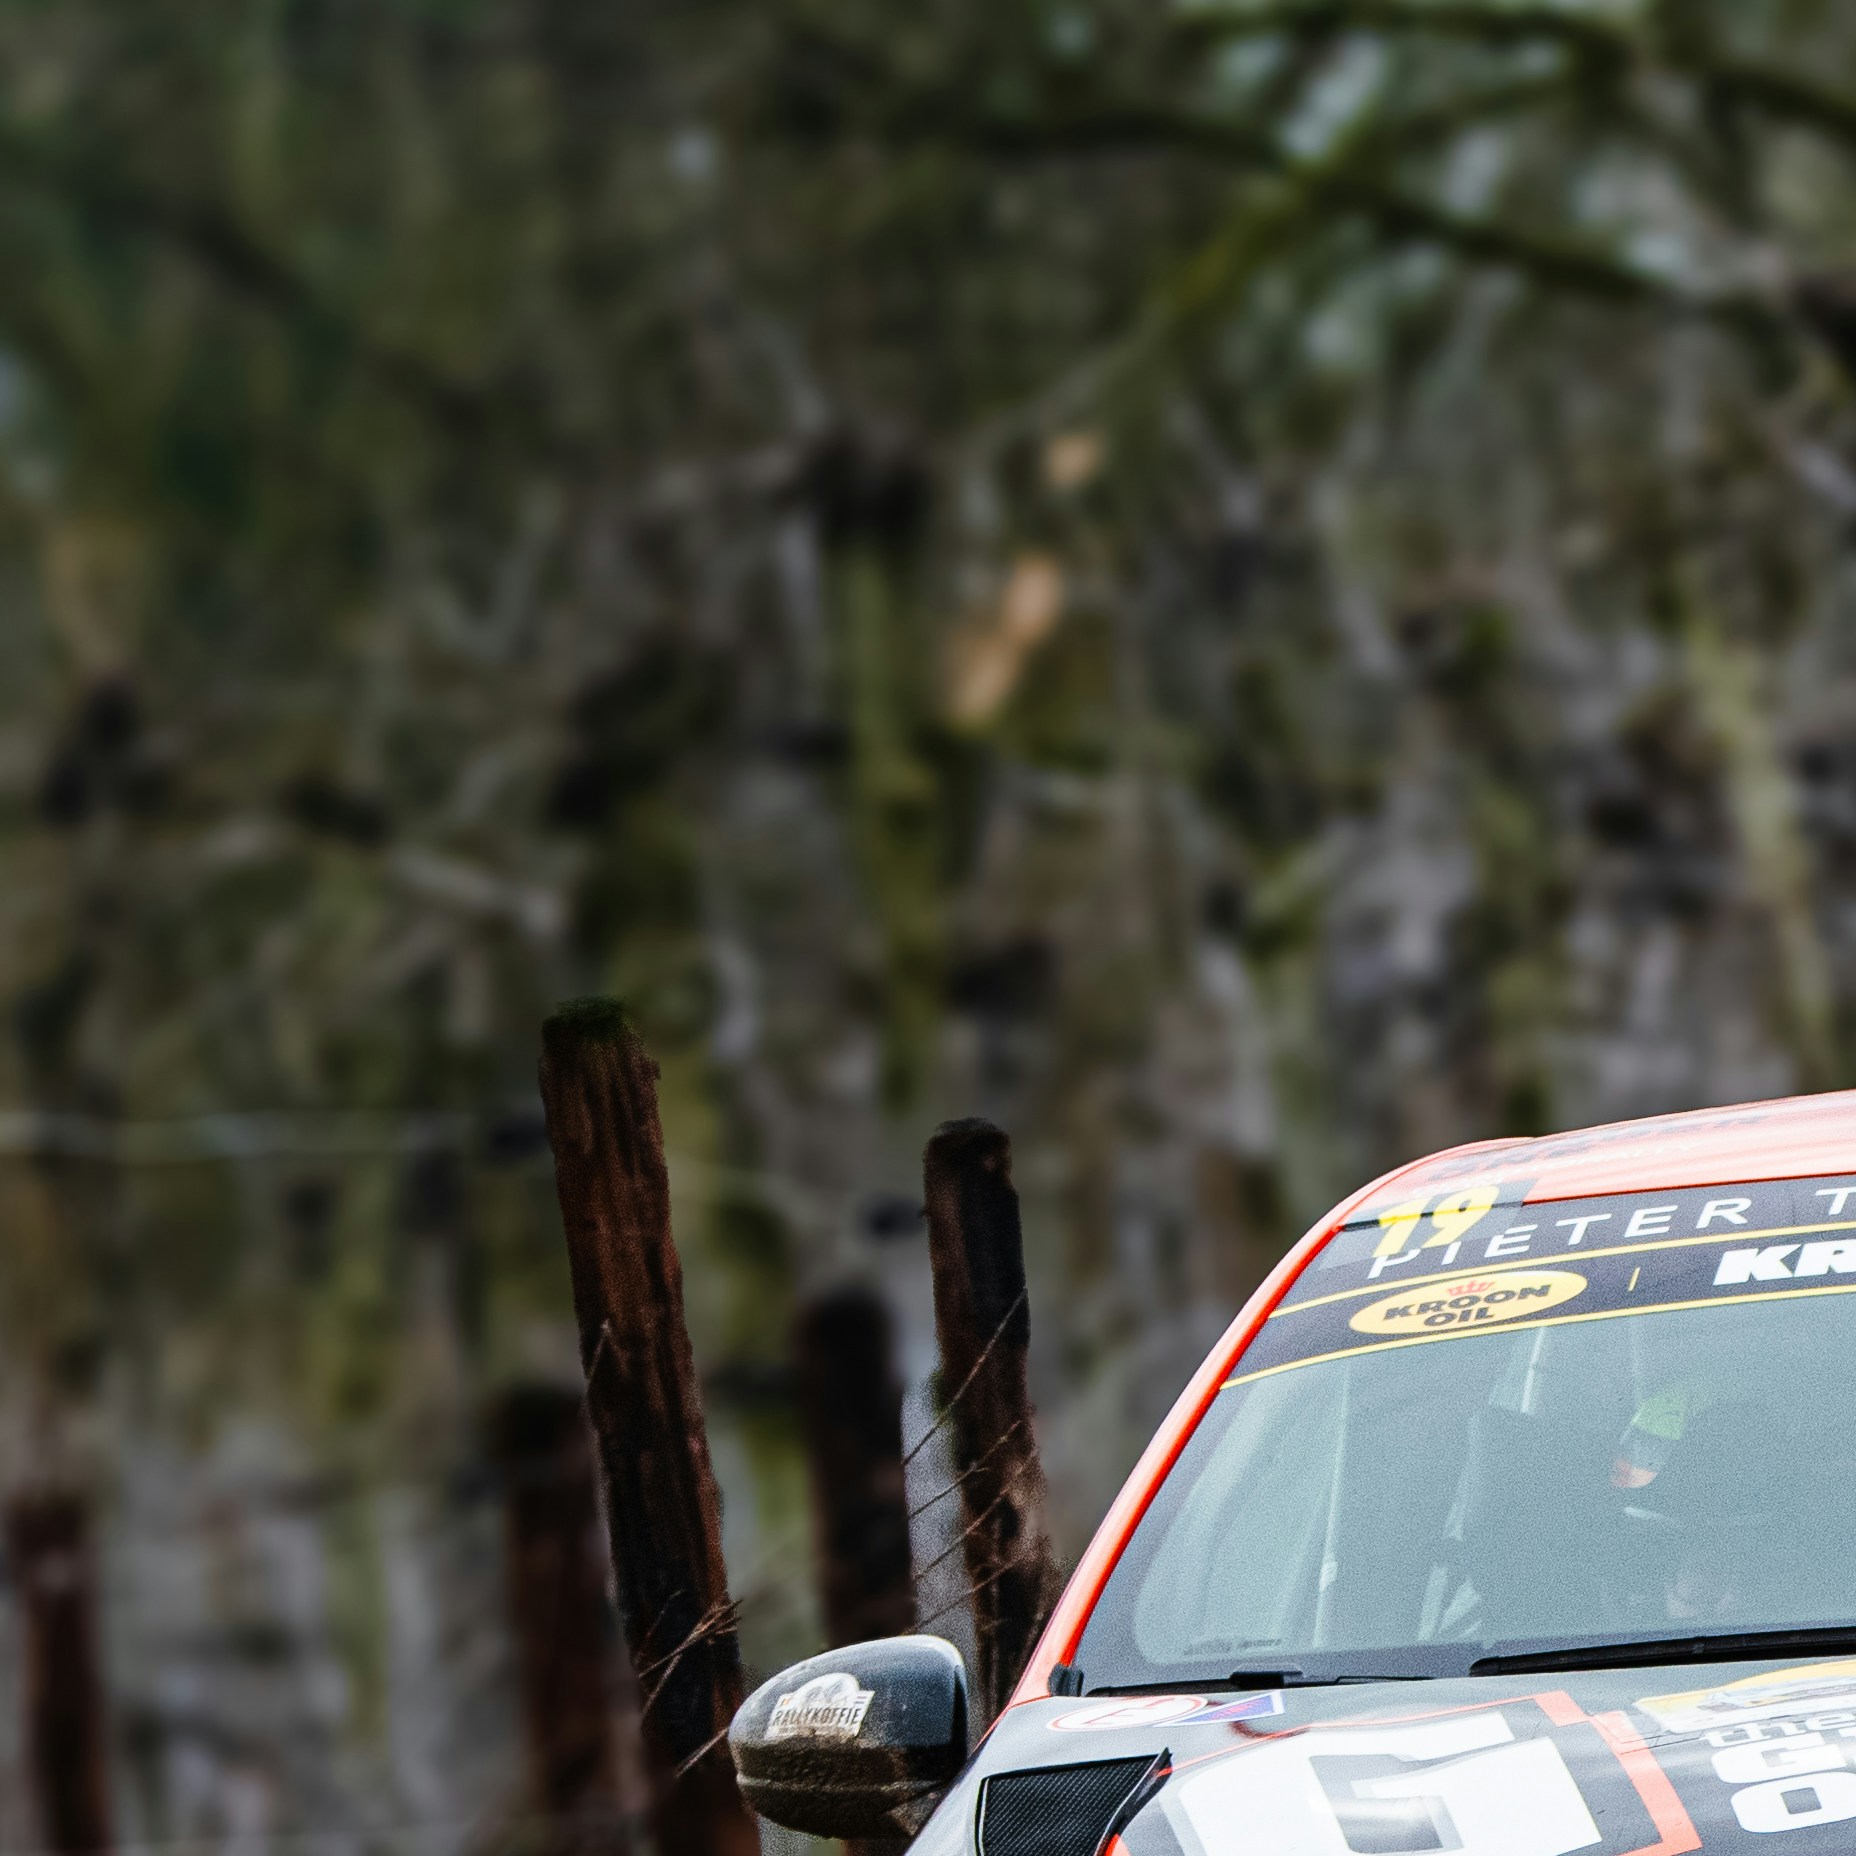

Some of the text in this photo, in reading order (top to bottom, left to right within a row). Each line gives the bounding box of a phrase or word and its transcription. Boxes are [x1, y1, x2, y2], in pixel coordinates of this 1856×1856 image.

[1367, 1198, 1752, 1279] PIETER
[1372, 1184, 1500, 1259] 19
[1383, 1284, 1552, 1322] KROON
[1423, 1303, 1494, 1328] OIL
[772, 1706, 862, 1727] RALLYKOFFIE
[1701, 1710, 1856, 1748] the
